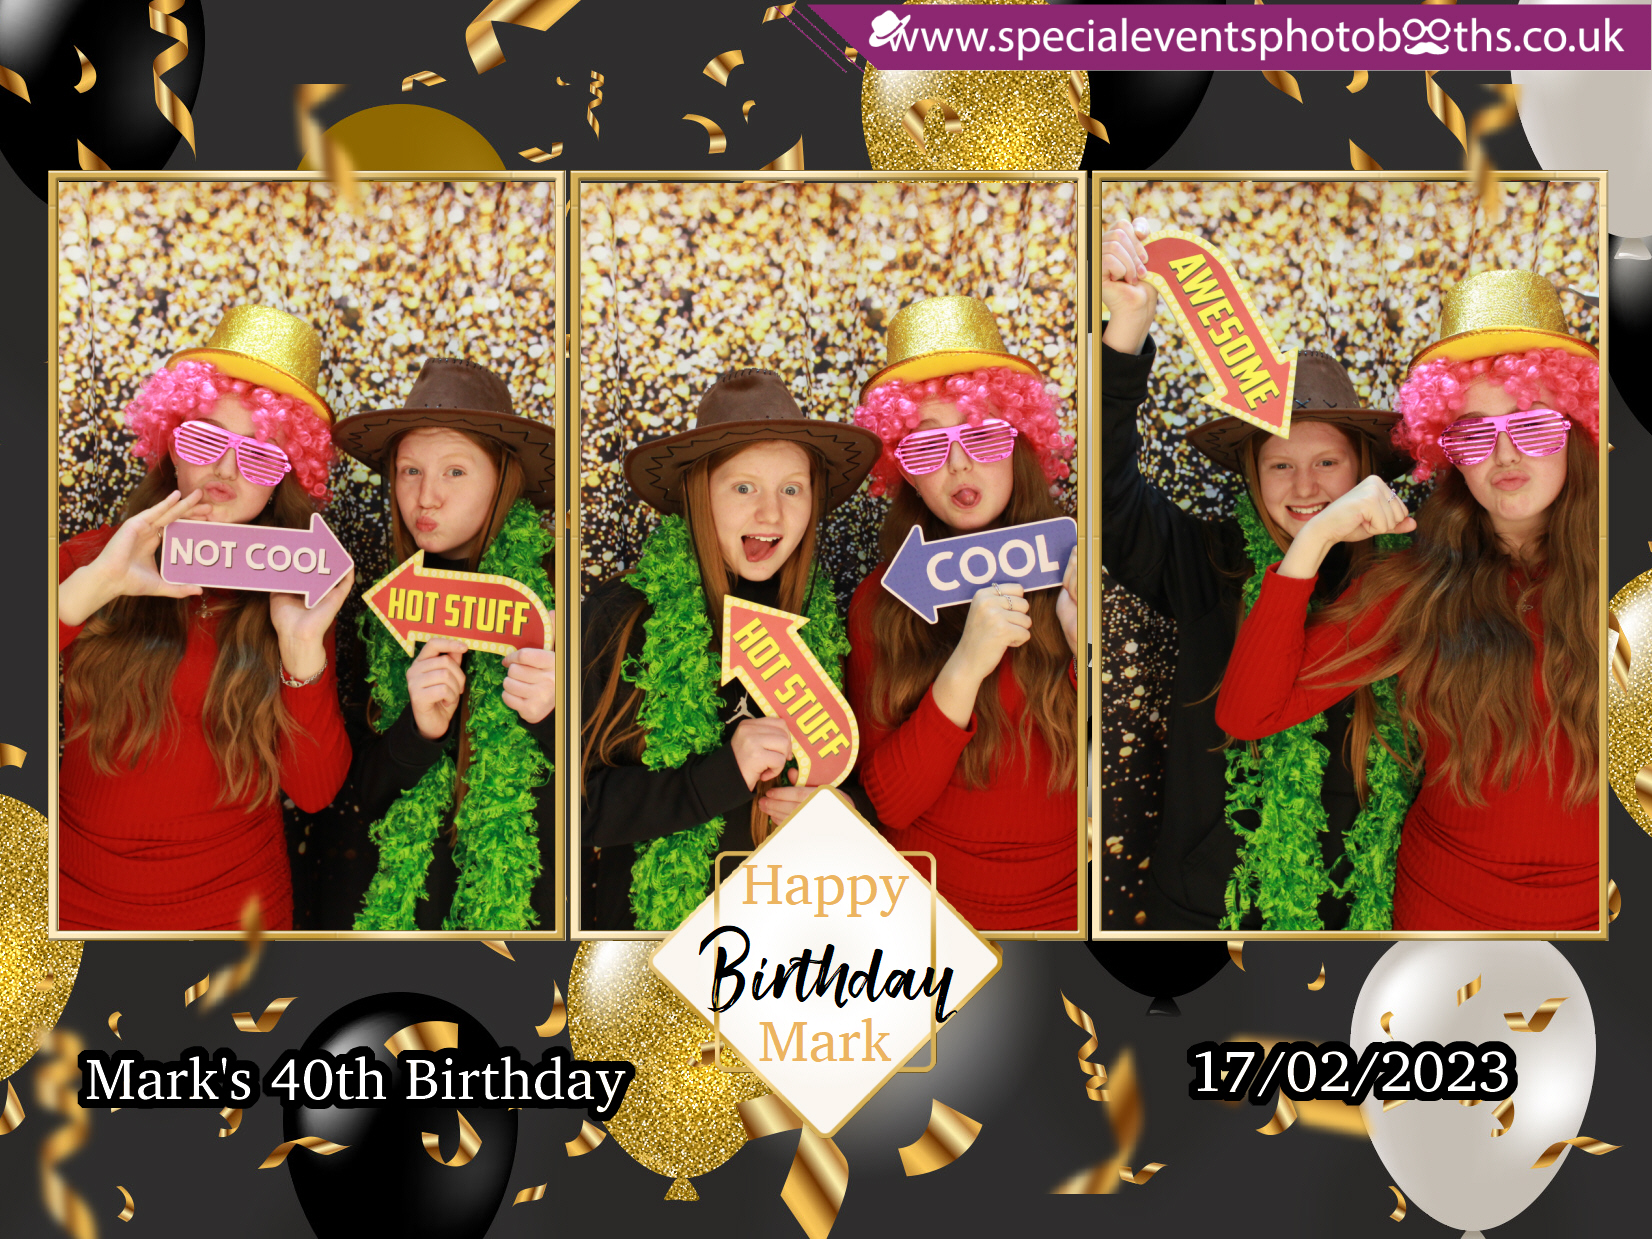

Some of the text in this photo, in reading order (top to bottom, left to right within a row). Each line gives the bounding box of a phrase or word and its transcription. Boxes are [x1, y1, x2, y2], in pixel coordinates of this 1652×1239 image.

[1168, 253, 1280, 410] AWESOME
[169, 537, 331, 576] NOT COOL
[926, 534, 1060, 592] COOL
[387, 586, 531, 637] HOT STUFF
[732, 617, 851, 760] HOT STUFF
